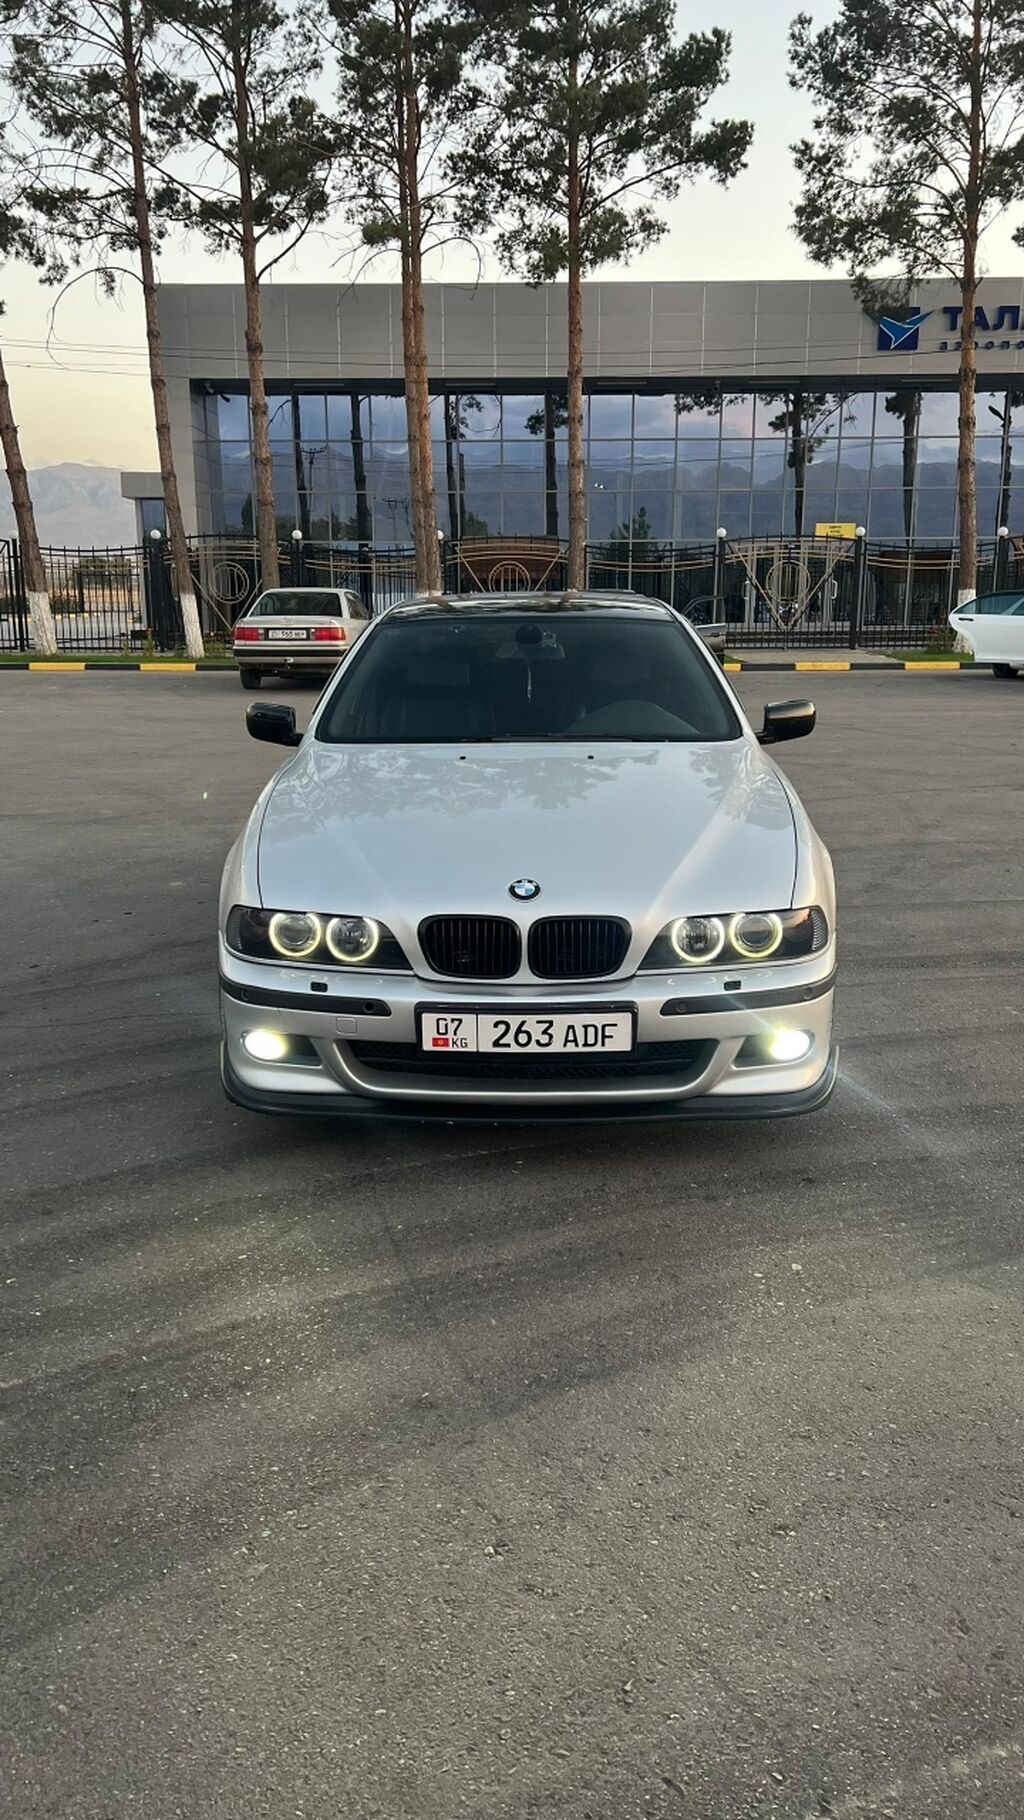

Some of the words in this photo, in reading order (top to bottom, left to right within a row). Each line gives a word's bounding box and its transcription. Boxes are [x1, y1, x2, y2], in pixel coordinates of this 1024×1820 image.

[943, 305, 1024, 331] ТАЛ
[436, 1017, 463, 1036] 07
[492, 1020, 554, 1048] 263
[563, 1023, 618, 1048] ADF
[451, 1037, 468, 1048] KG
